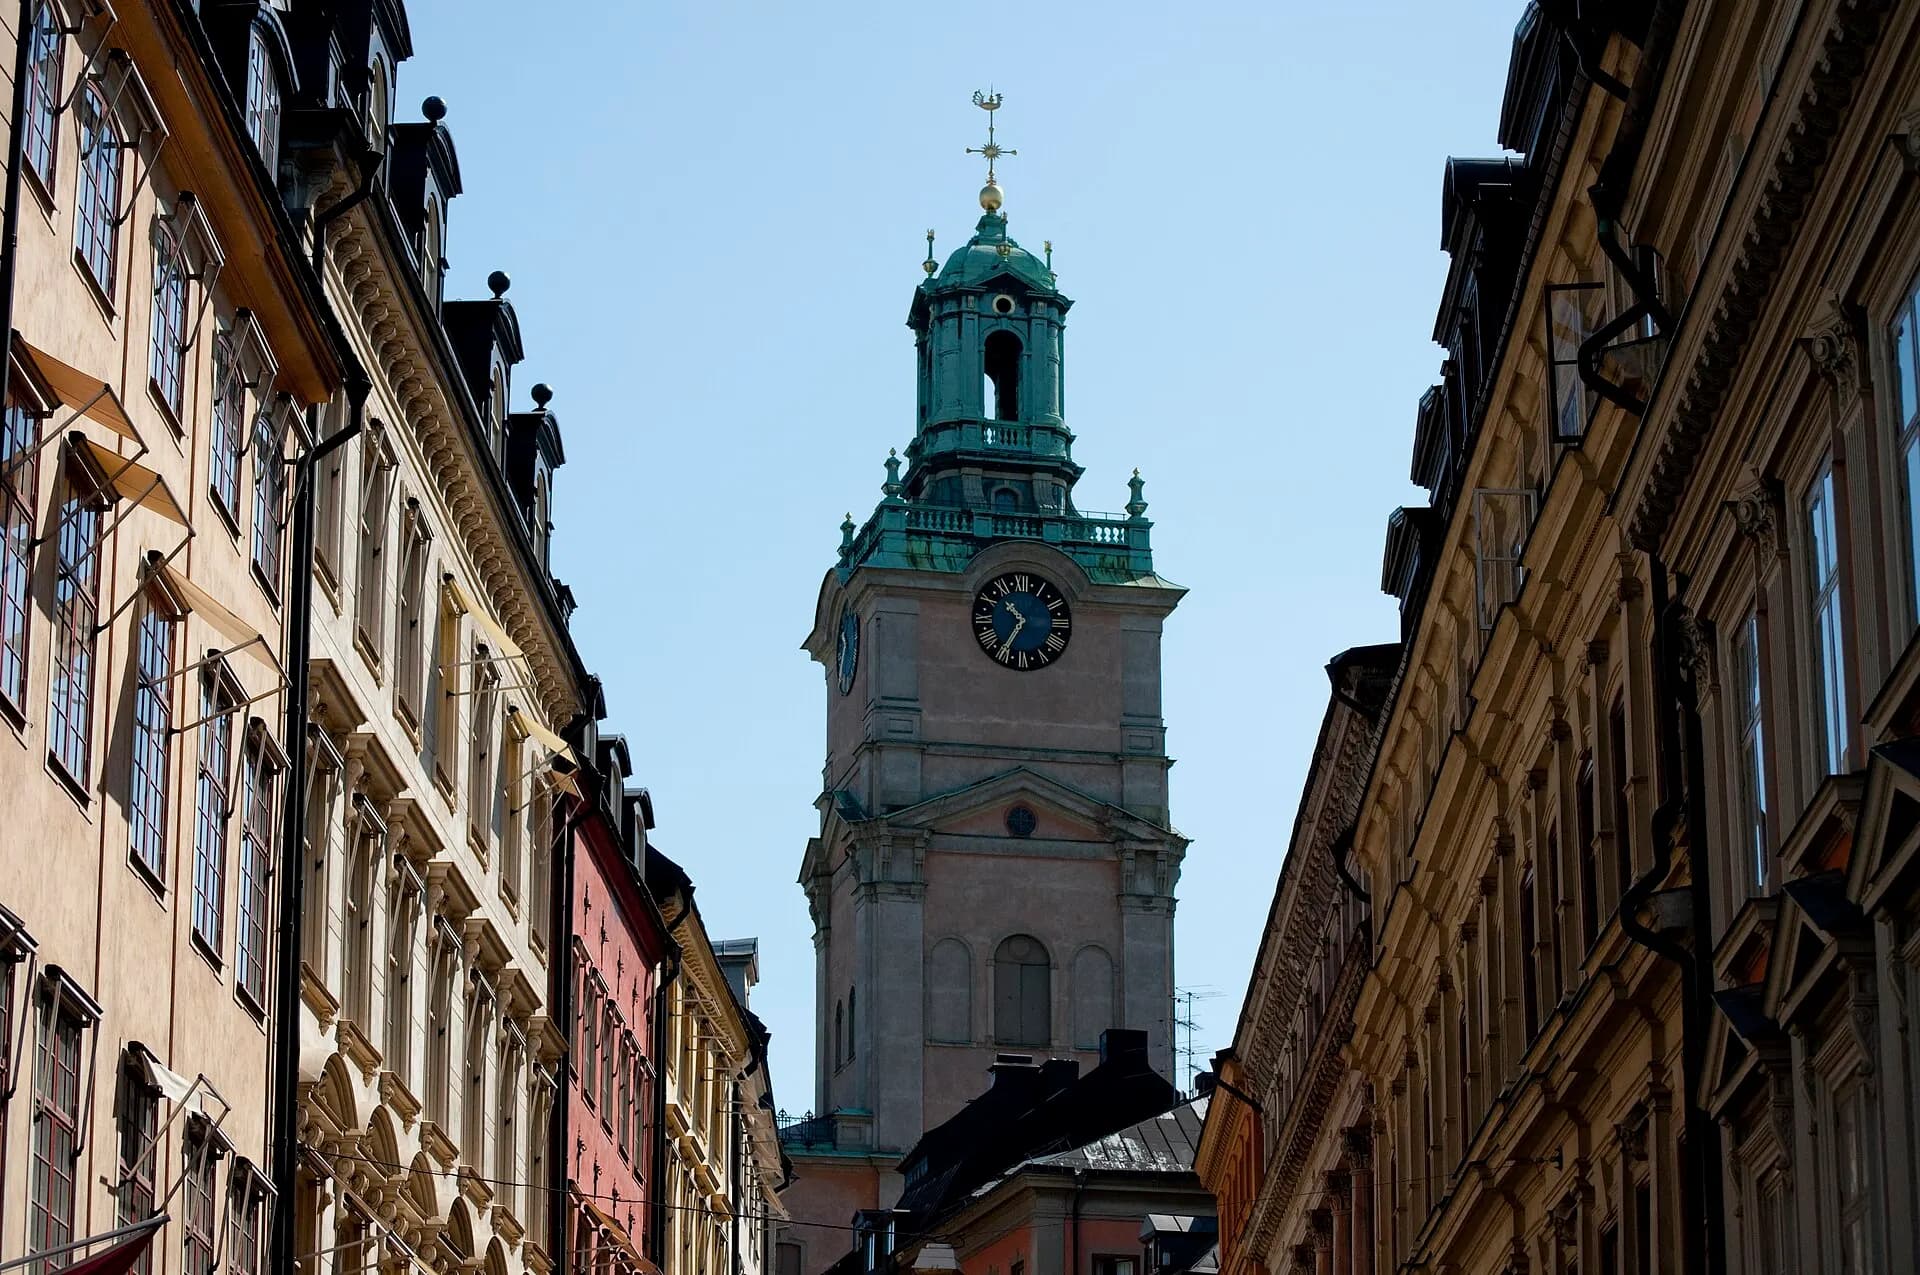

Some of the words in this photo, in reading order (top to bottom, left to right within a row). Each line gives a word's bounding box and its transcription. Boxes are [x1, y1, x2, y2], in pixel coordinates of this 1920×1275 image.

[993, 577, 1010, 597] XI
[1015, 575, 1029, 592] XII
[1036, 582, 1046, 597] I
[980, 592, 998, 607] X
[1047, 598, 1064, 610] II
[975, 613, 993, 624] IX
[1051, 618, 1070, 628] III
[978, 628, 998, 649] VIII
[1045, 633, 1065, 651] IIII
[1018, 651, 1029, 668] VI
[1037, 649, 1049, 664] V
